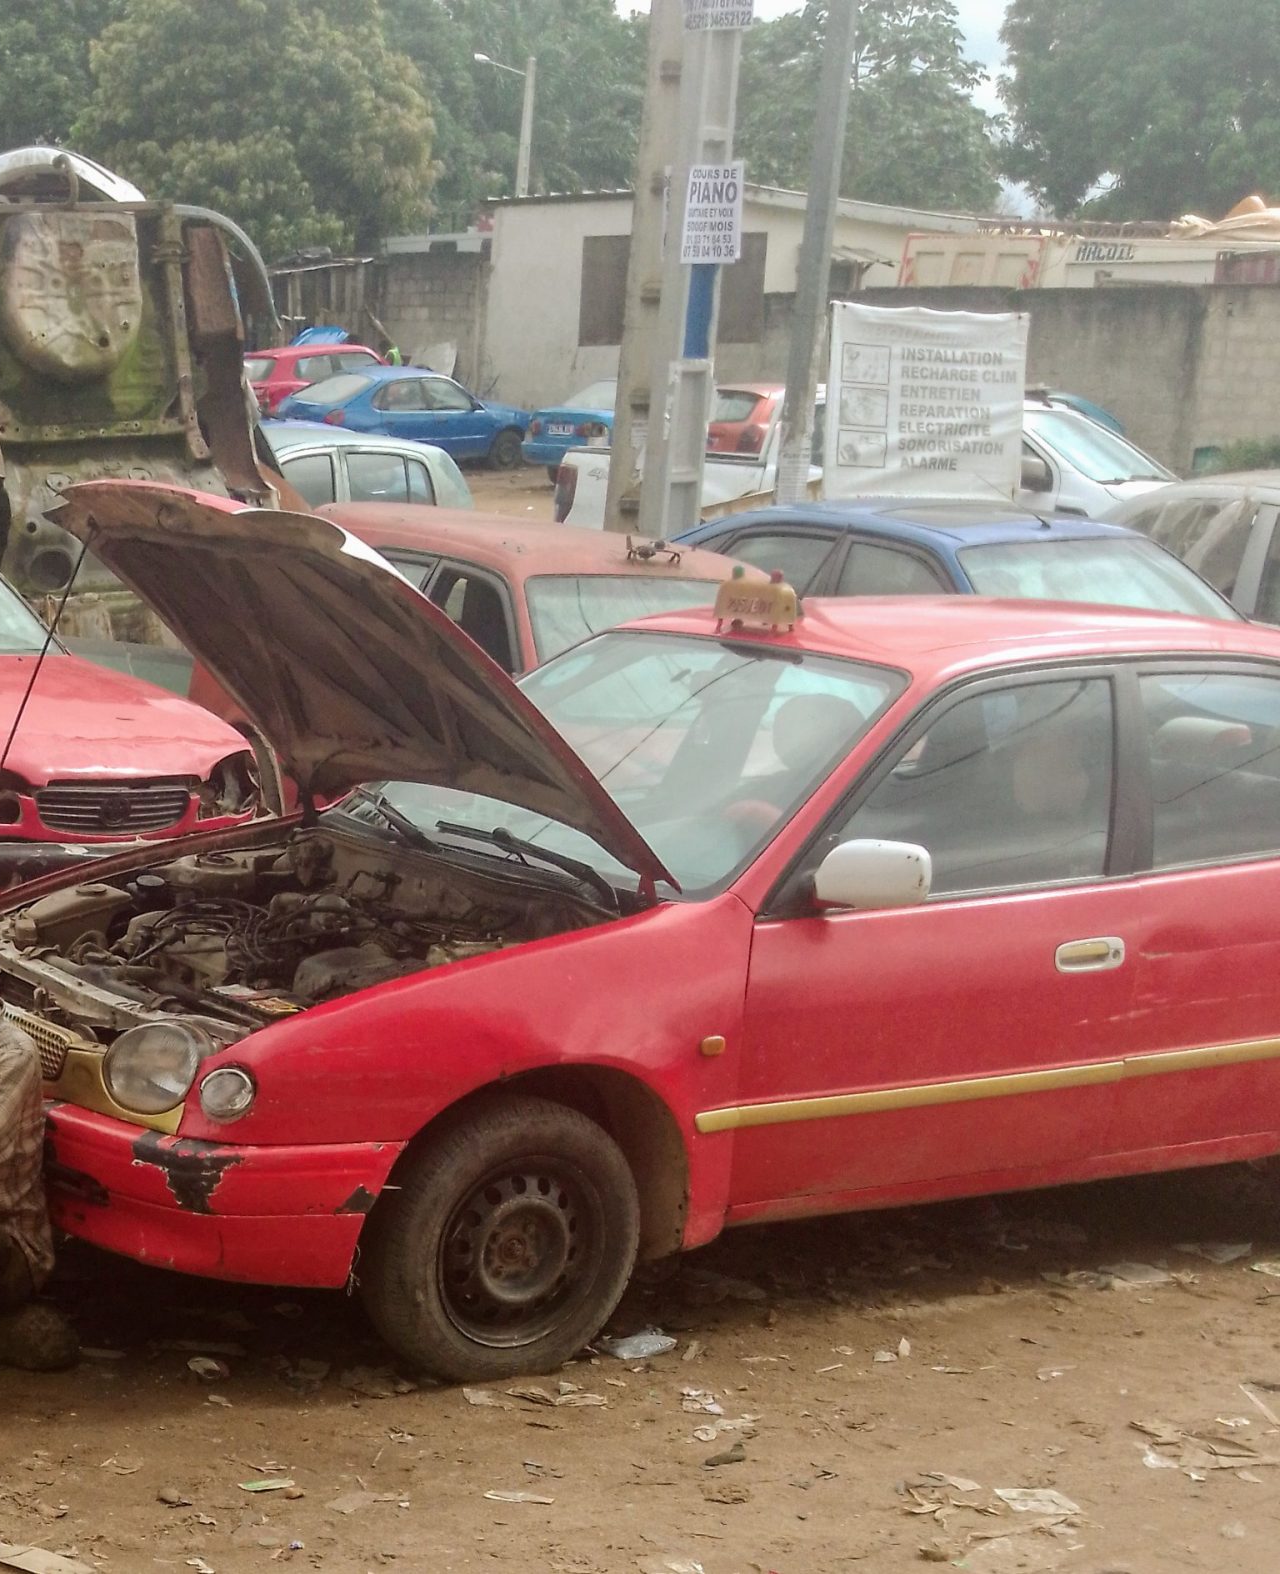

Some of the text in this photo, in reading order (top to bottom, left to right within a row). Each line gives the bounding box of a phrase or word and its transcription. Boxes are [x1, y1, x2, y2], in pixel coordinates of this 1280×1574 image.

[692, 168, 738, 180] COURS DE
[689, 181, 738, 204] PIANO
[712, 245, 722, 257] 10
[723, 244, 735, 257] 36
[900, 346, 1003, 366] INSTALLATION
[901, 366, 1017, 384] RECHARGE CLIM
[900, 386, 981, 401] ENTRETIEN
[899, 403, 991, 421] REPARATION
[898, 421, 991, 437] ELECTRICITE
[898, 438, 1004, 456] SONORISATION
[900, 457, 958, 472] ALARME
